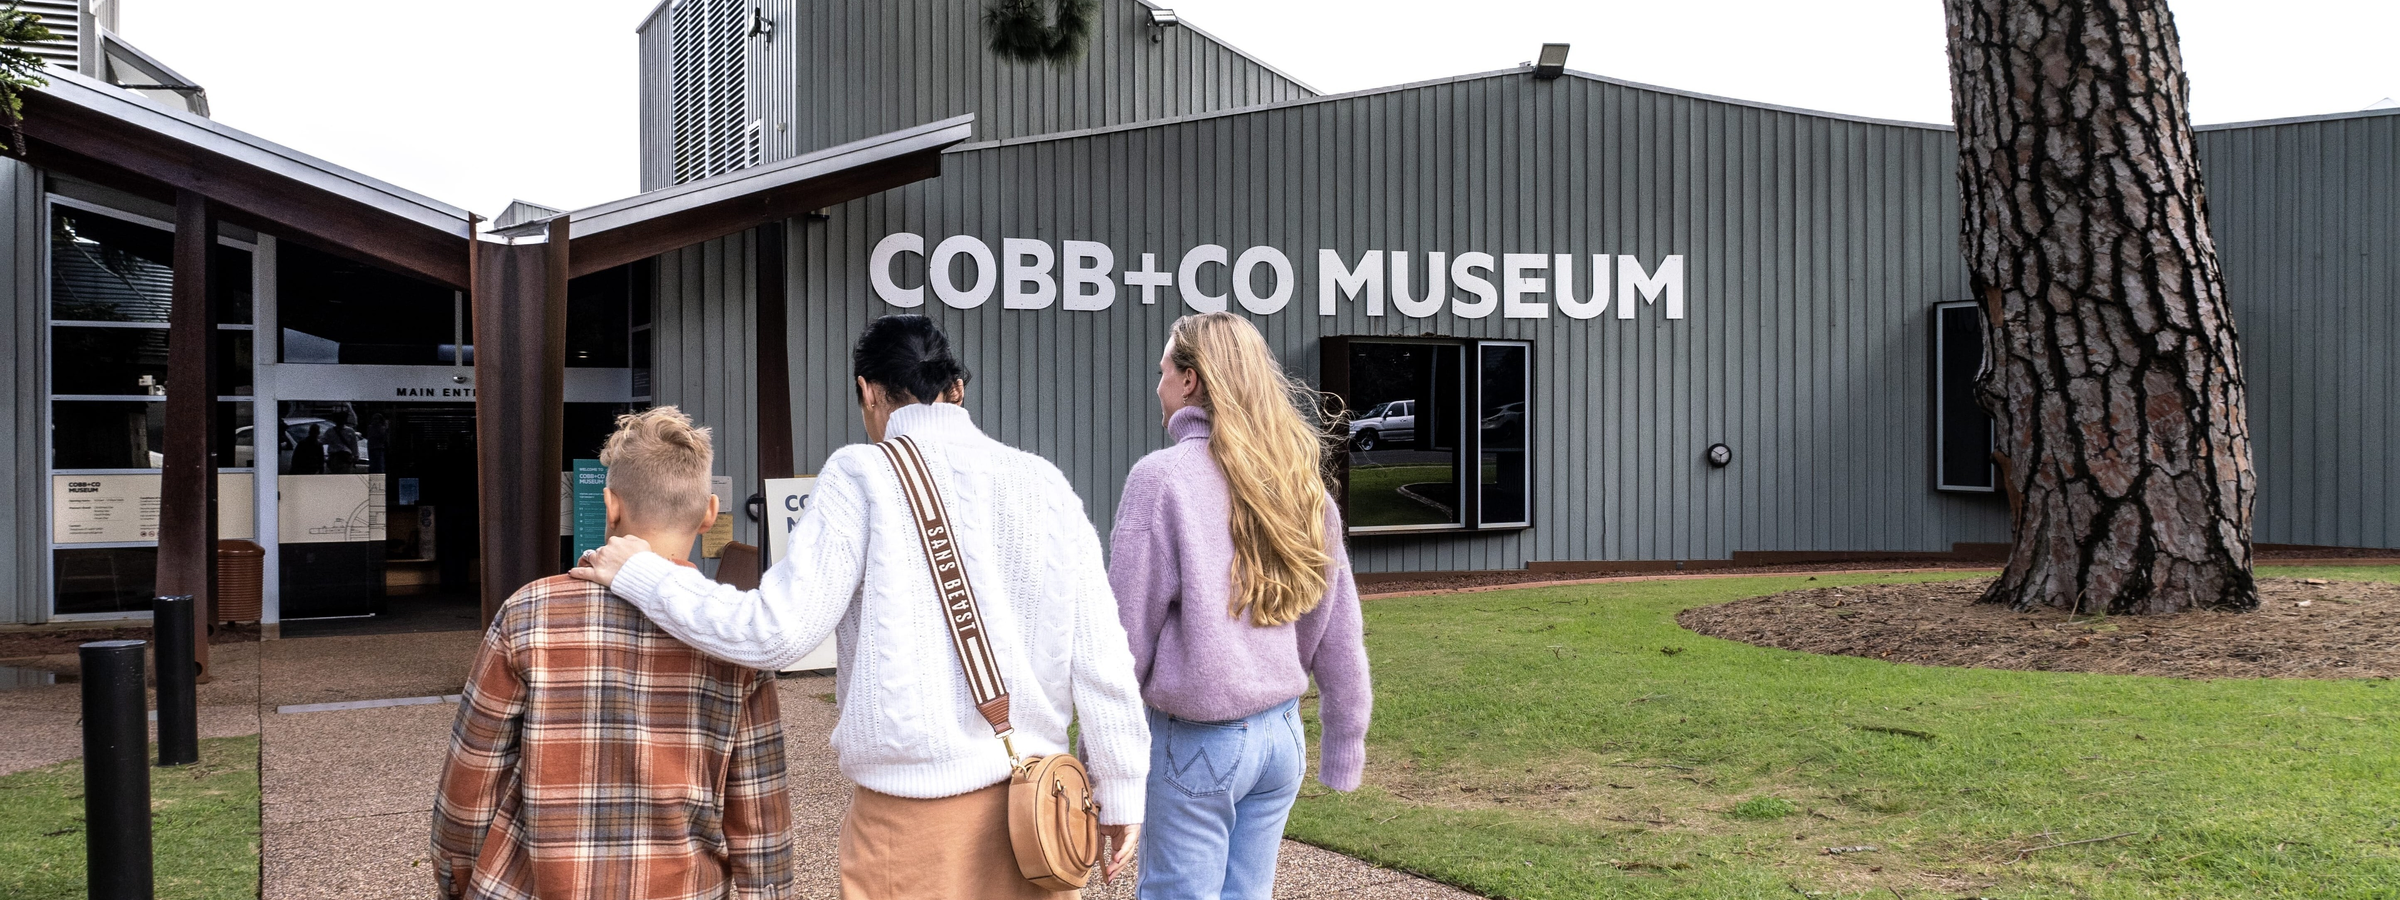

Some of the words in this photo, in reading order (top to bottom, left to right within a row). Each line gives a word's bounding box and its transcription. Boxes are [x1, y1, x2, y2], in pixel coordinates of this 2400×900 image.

[870, 232, 1294, 315] COBB+CO
[1319, 249, 1684, 319] MUSEUM
[396, 388, 435, 397] MAIN
[927, 525, 956, 572] SANS
[944, 578, 977, 632] BEAST
